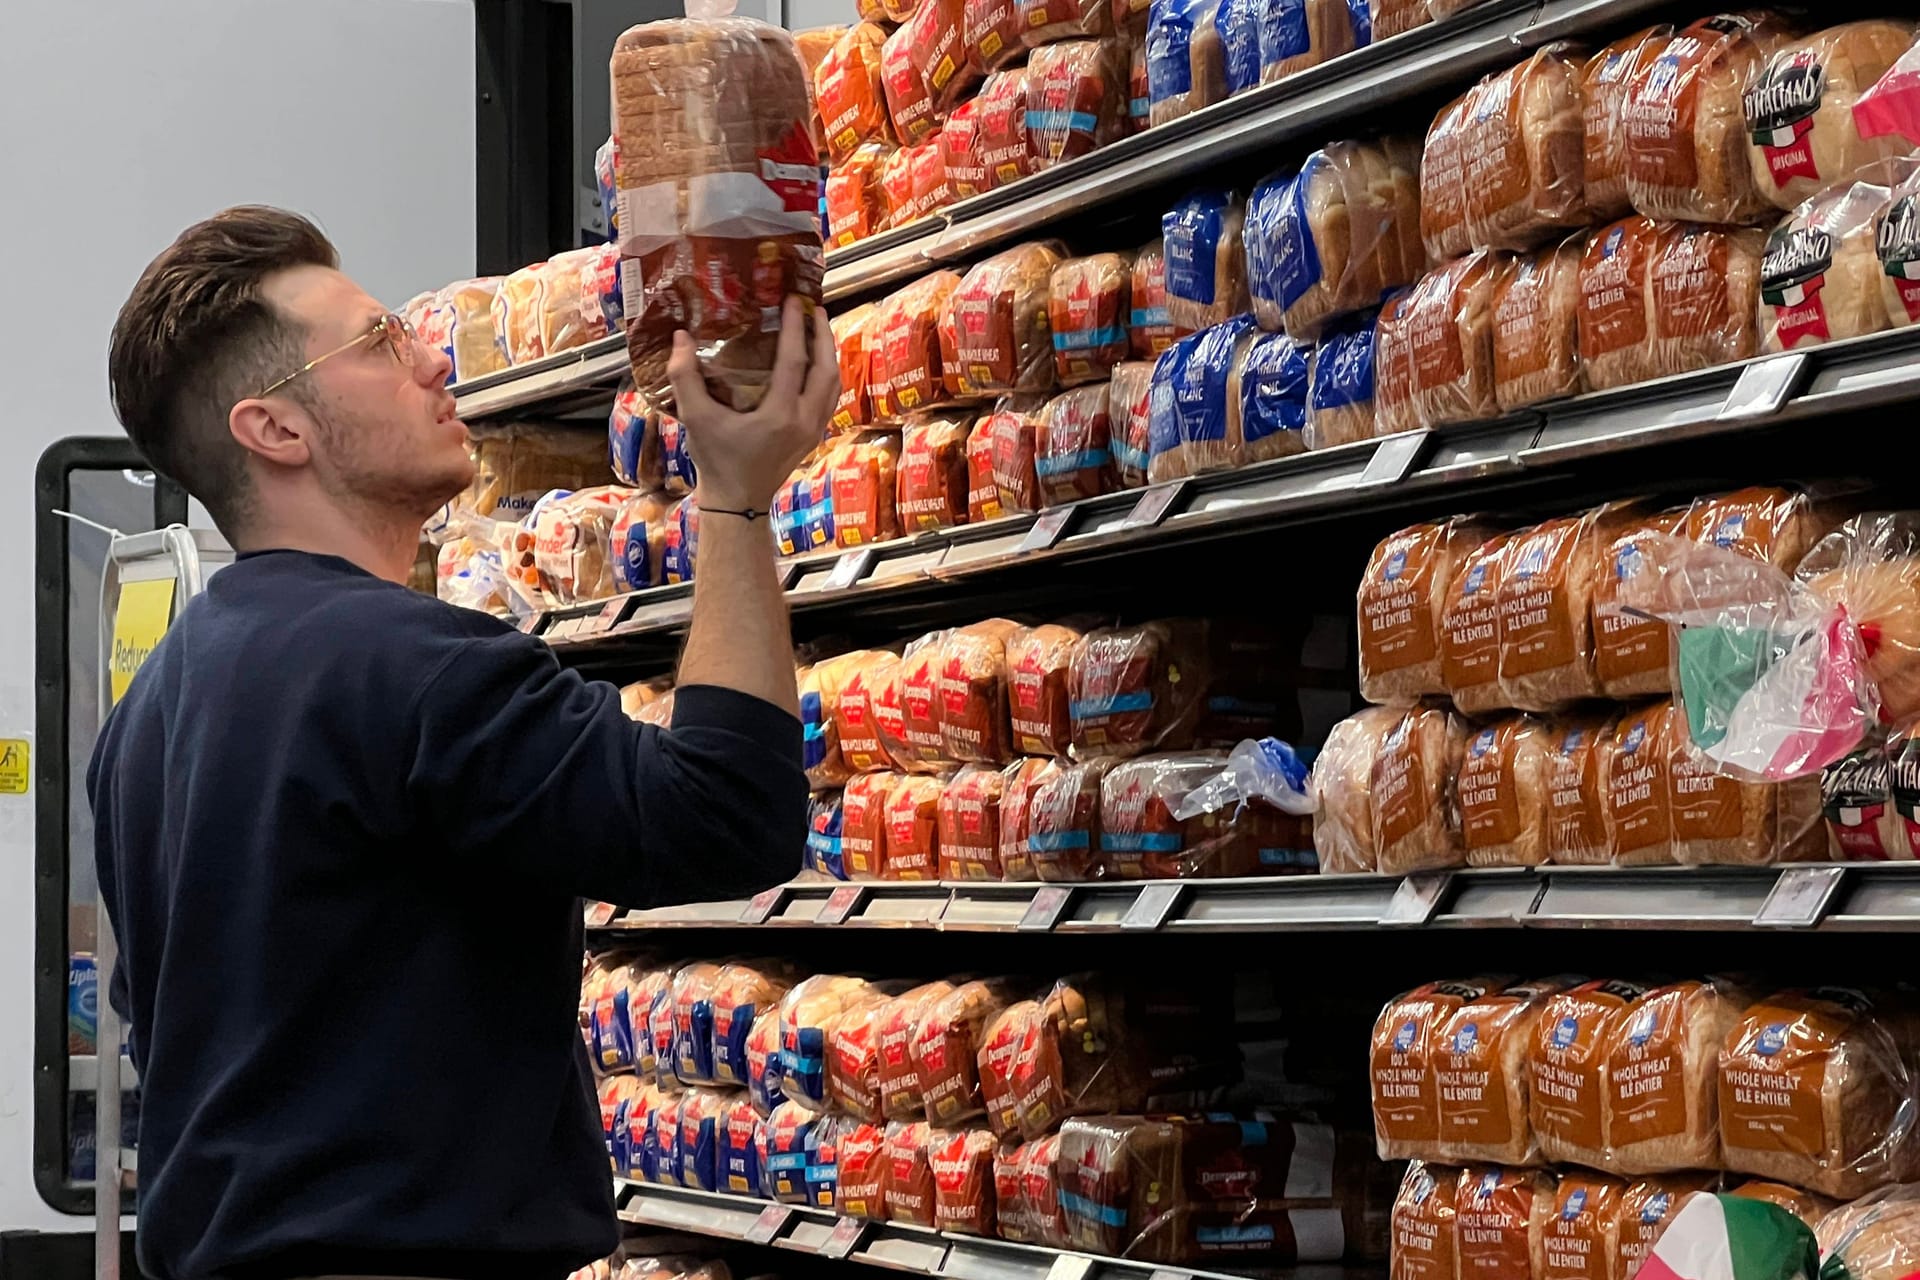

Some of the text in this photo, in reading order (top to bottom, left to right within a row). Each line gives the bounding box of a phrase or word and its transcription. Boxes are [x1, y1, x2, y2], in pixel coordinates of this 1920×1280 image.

[1364, 591, 1417, 616] WHOLE WHEAT
[1500, 591, 1552, 617] WHOLE WHEAT
[1385, 610, 1412, 630] ENTIER
[1443, 607, 1498, 631] WHOLE WHEAT
[1521, 609, 1548, 629] ENTIER
[1466, 623, 1494, 641] ENTIER
[1375, 1068, 1426, 1082] WHOLE WHEAT
[1461, 1071, 1489, 1087] WHEAT
[1532, 1061, 1585, 1088] WHOLE WHEAT
[1613, 1059, 1670, 1082] WHOLE WHEAT
[1726, 1069, 1801, 1090] WHOLE WHEAT
[1395, 1084, 1420, 1098] ENTIER
[1456, 1086, 1482, 1101] ENTIER
[1551, 1081, 1578, 1102] ENTIER
[1634, 1075, 1663, 1096] ENTIER
[1754, 1090, 1791, 1106] ENTIER
[1567, 1238, 1592, 1253] WHEAT
[1561, 1254, 1585, 1269] ENTIER
